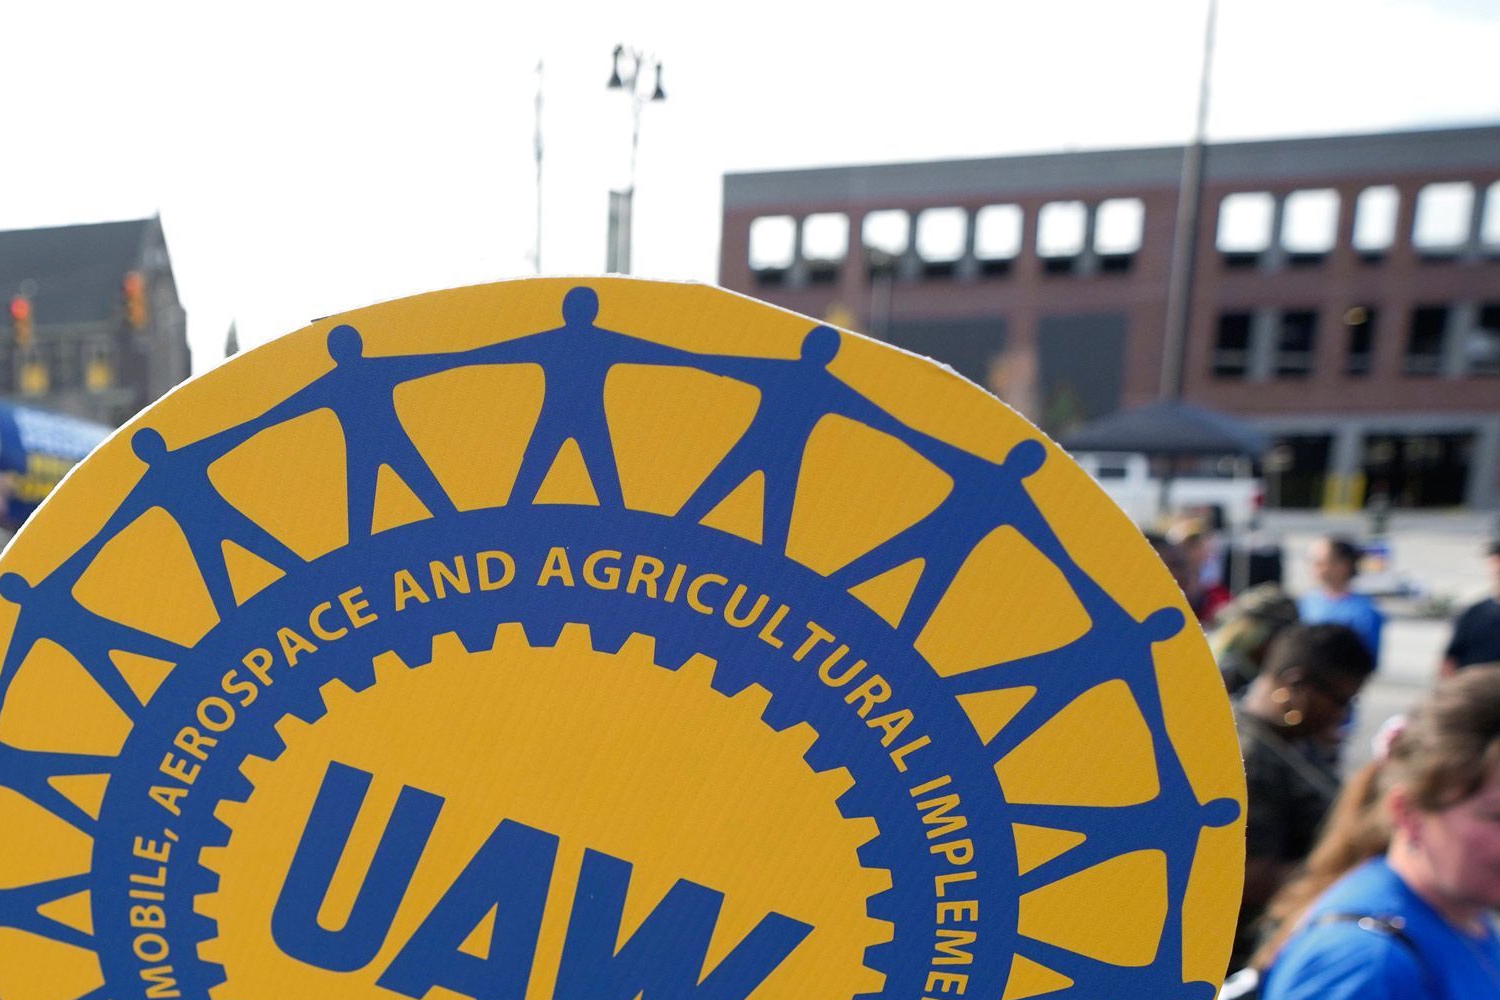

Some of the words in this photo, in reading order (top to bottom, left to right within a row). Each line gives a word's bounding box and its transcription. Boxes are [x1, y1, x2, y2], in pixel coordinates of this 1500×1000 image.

[148, 586, 379, 816] AEROSPACE
[394, 550, 516, 612] AND
[536, 547, 932, 773] AGRICULTURAL
